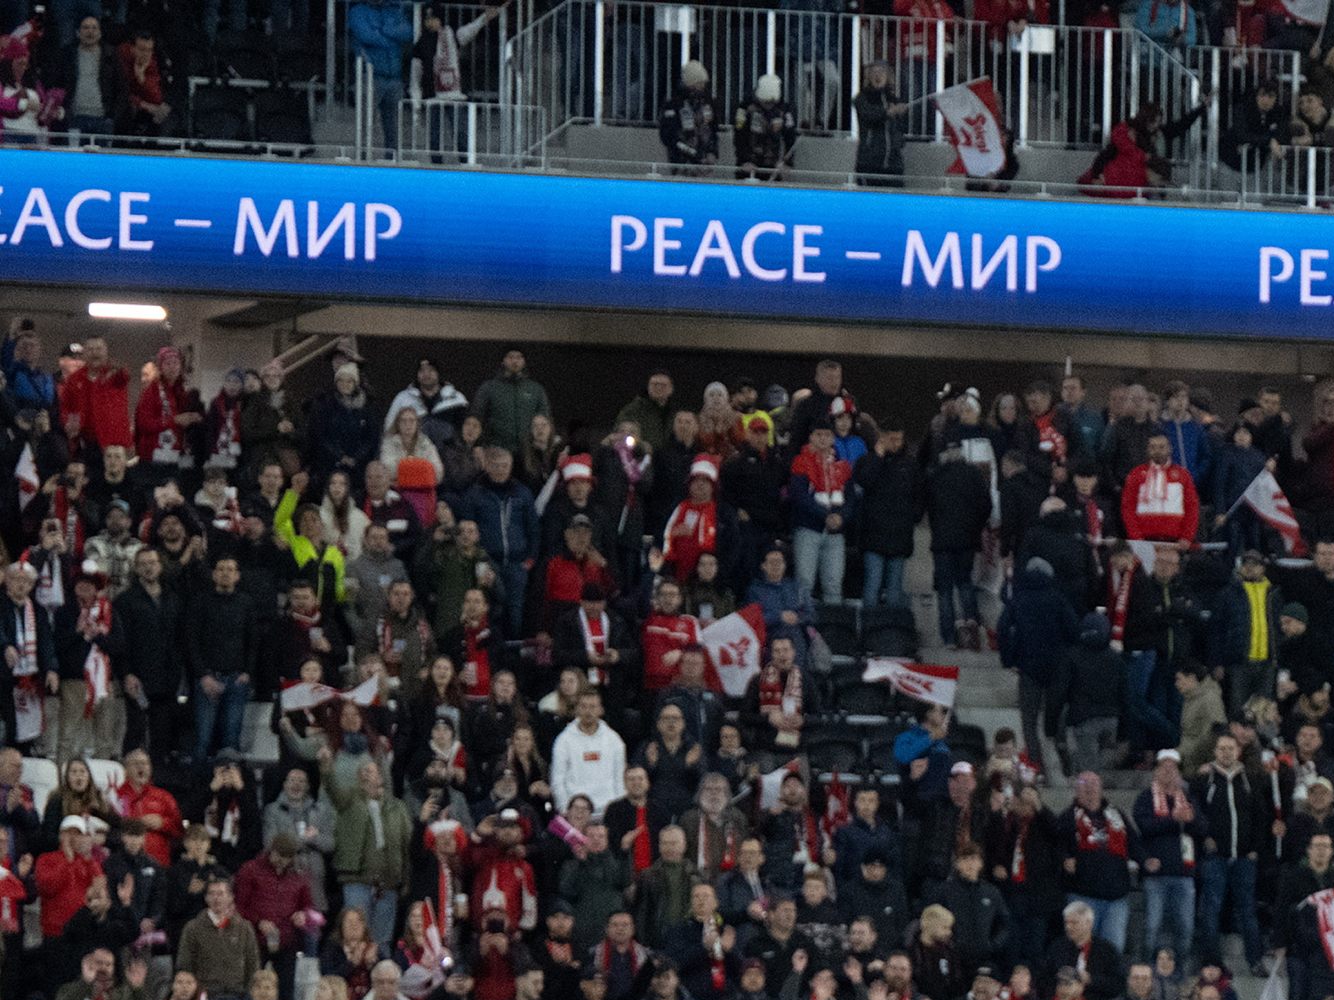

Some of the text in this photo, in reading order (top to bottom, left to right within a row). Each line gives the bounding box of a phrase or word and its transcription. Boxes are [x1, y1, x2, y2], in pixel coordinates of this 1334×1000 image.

[0, 186, 154, 251] ACE
[233, 197, 402, 261] МИР
[610, 215, 826, 283] PEACE
[901, 230, 1061, 292] МИР
